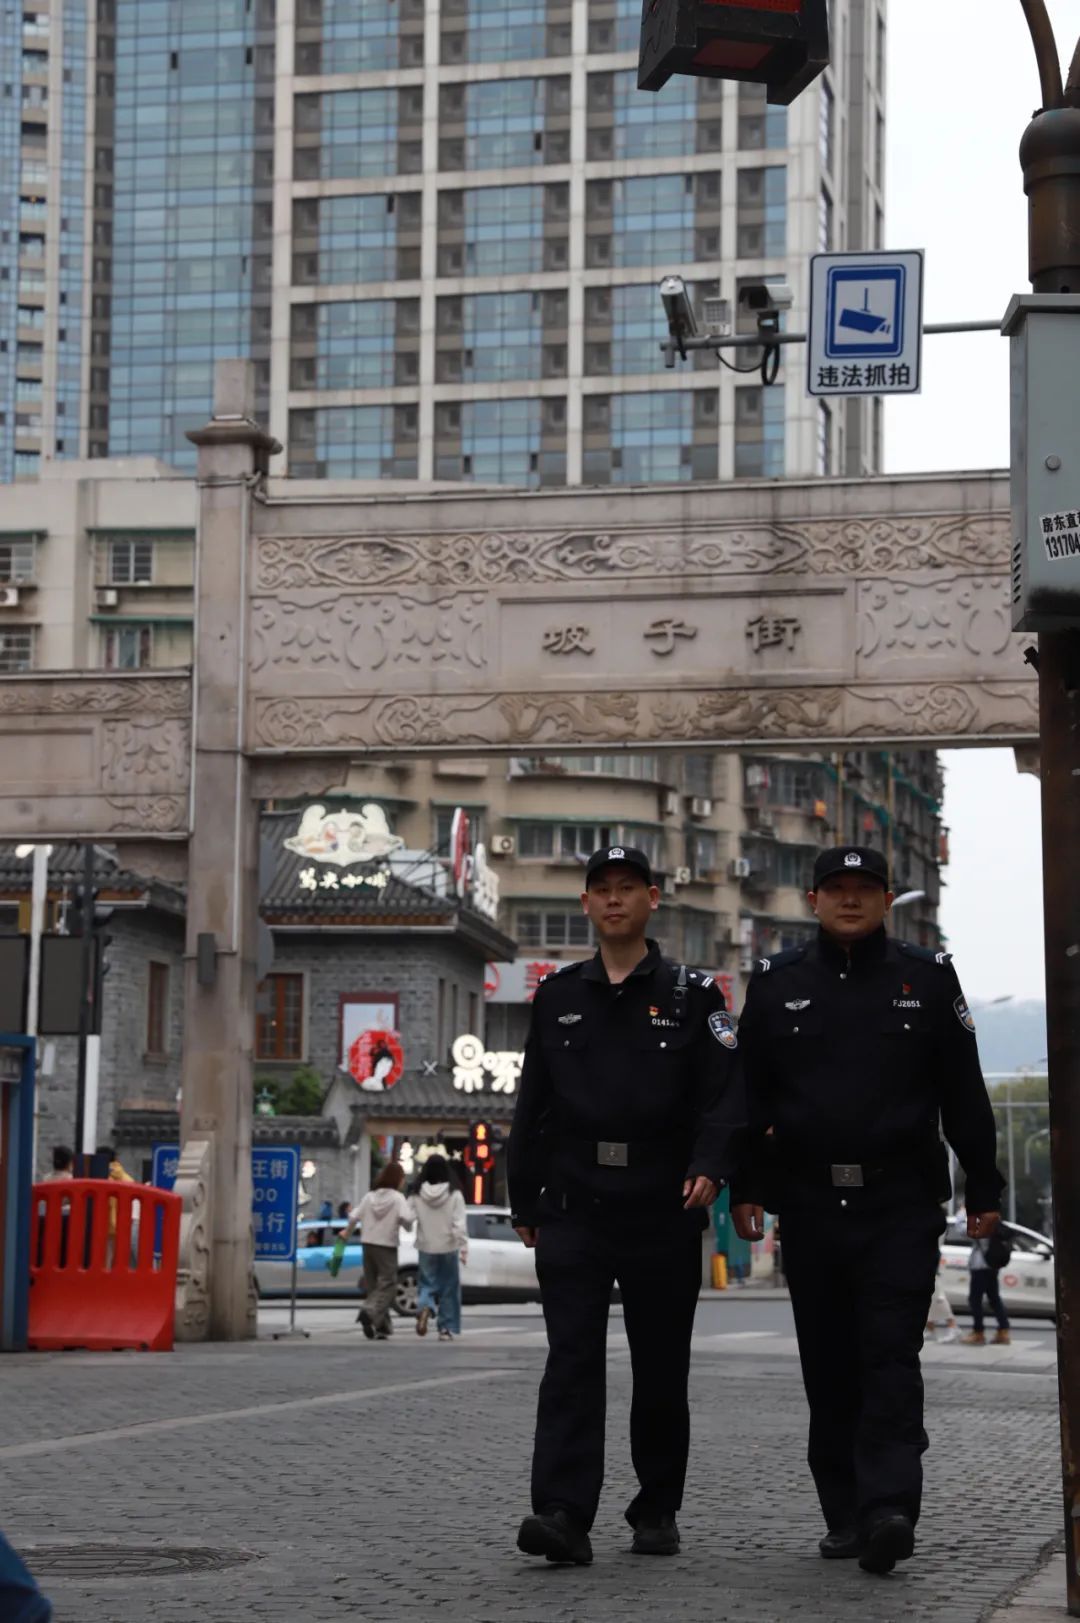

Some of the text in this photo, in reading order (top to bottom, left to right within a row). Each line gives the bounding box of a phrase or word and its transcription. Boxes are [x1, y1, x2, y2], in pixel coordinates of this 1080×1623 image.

[817, 363, 910, 388] 违法抓拍
[1046, 532, 1080, 558] 131704
[542, 615, 800, 656] 坡子街
